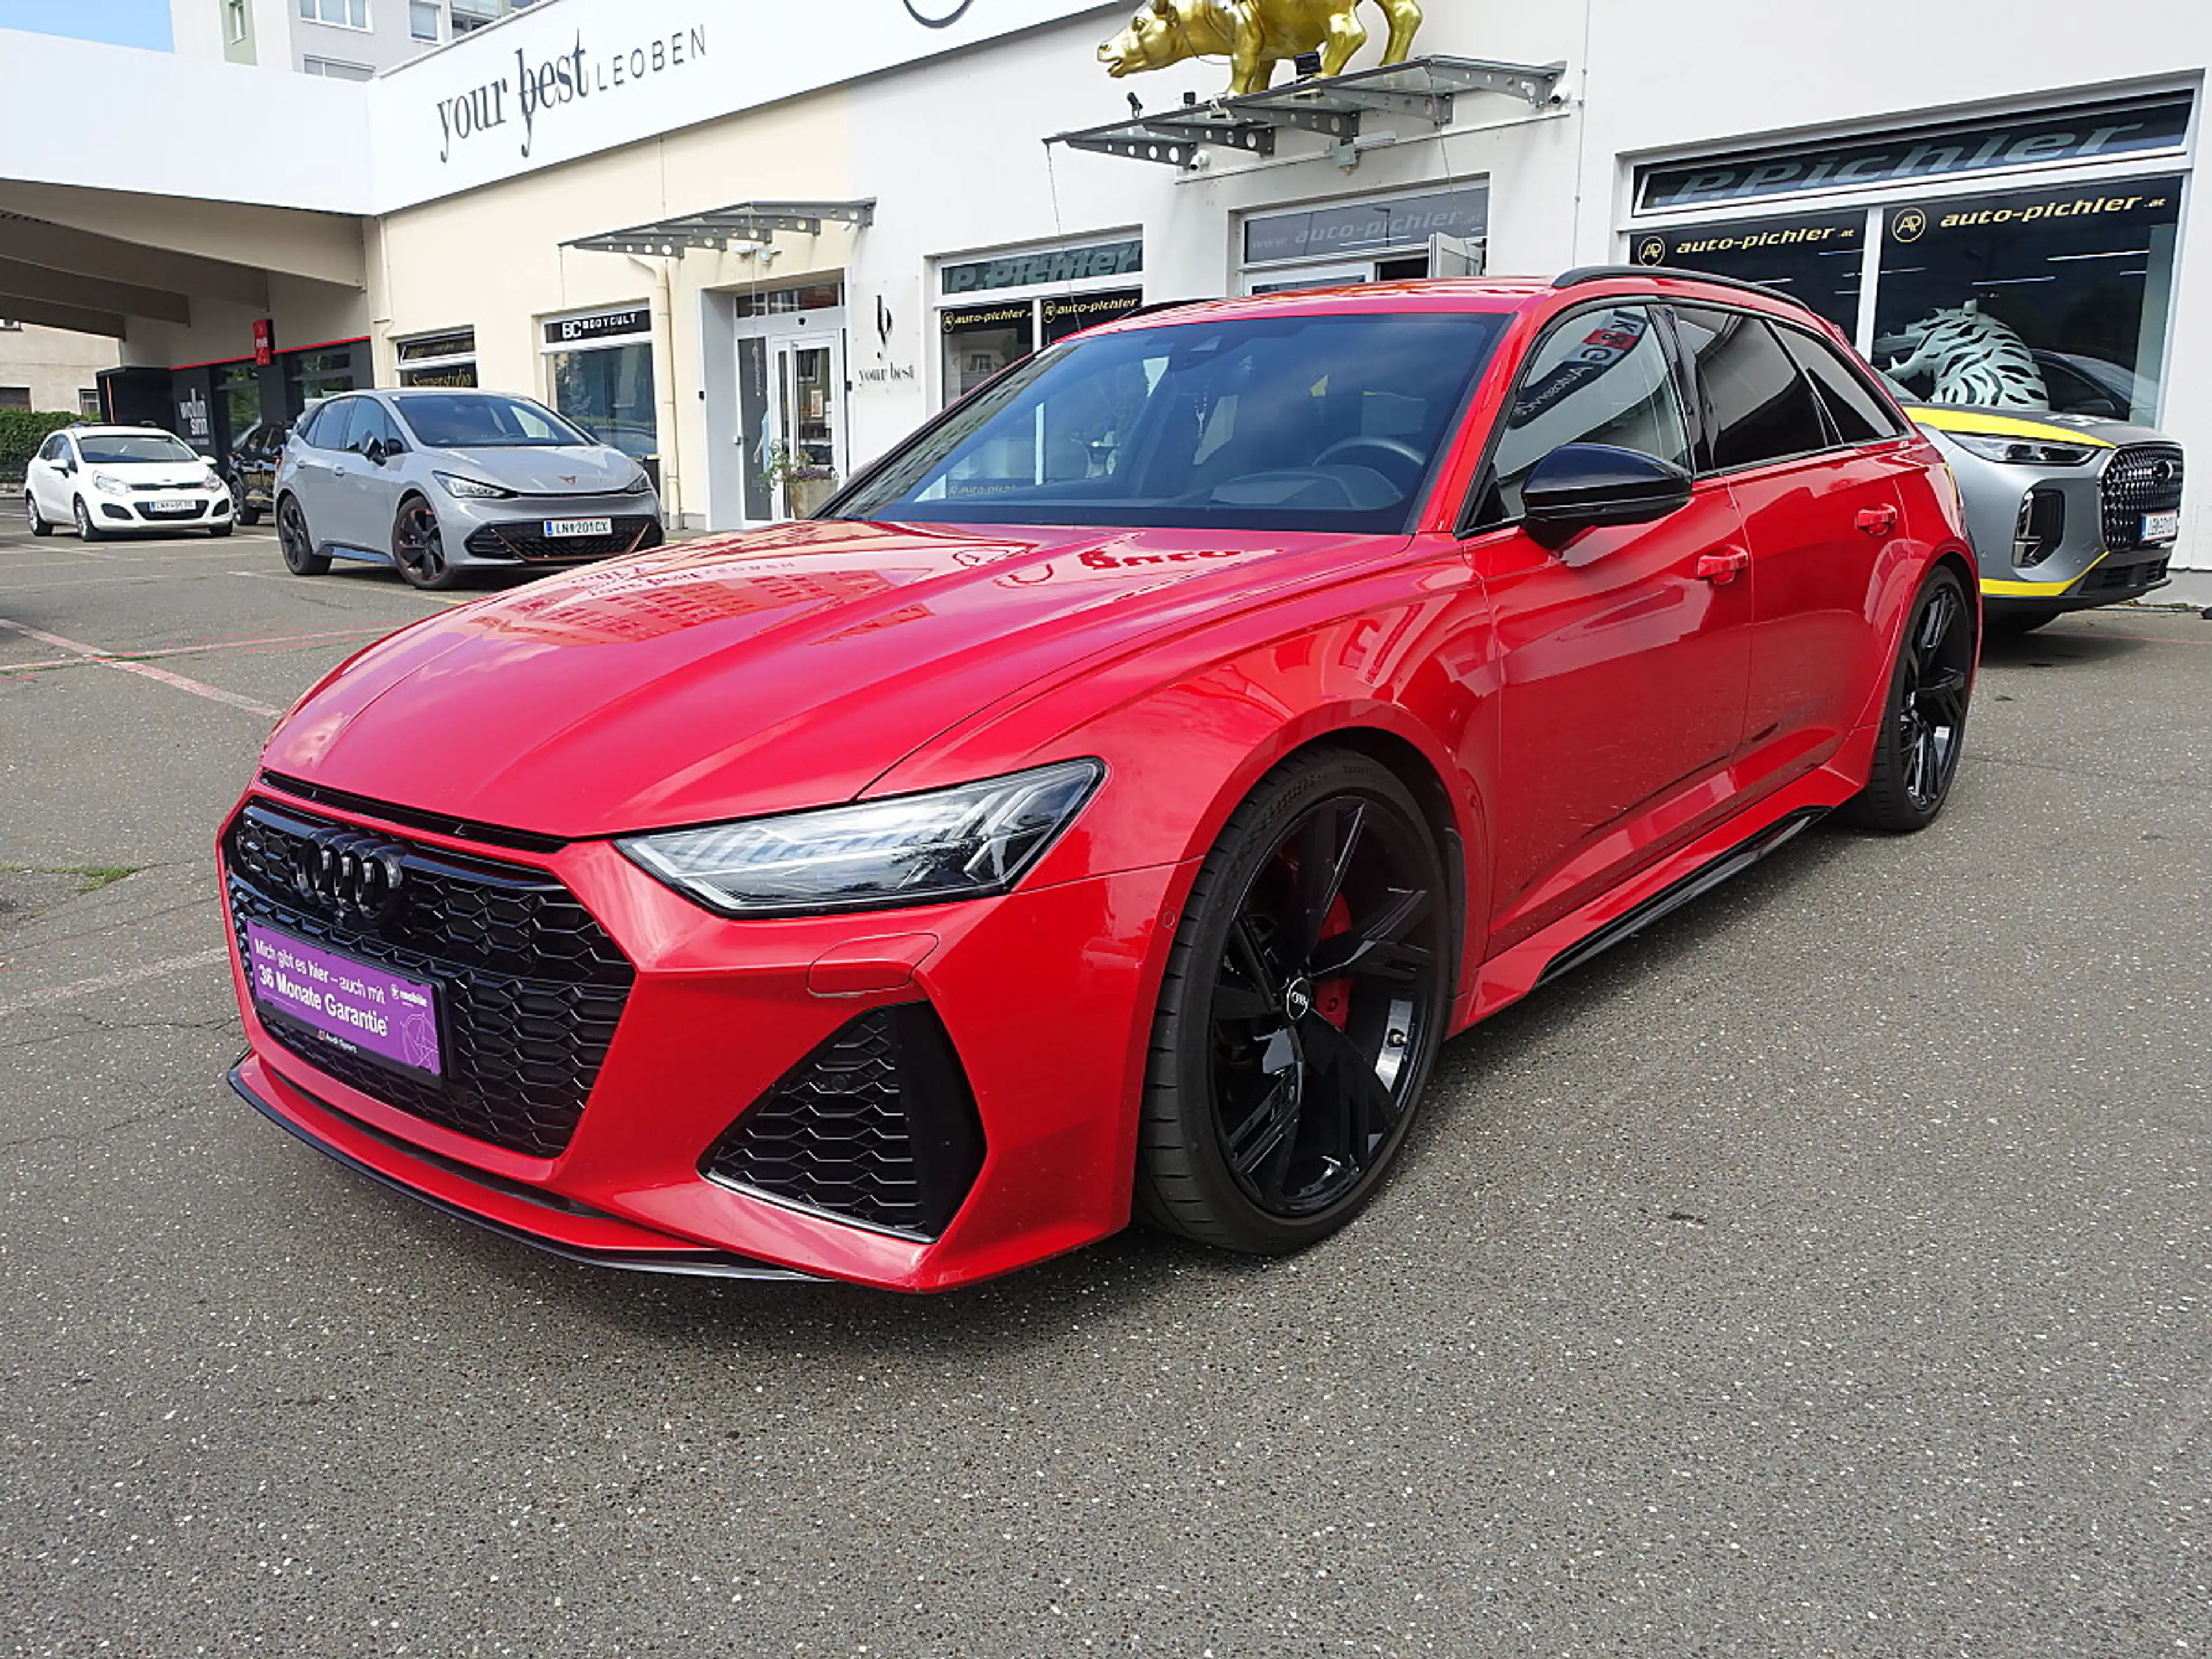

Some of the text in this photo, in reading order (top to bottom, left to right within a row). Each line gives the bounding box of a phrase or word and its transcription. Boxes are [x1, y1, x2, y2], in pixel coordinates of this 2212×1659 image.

[437, 24, 707, 163] your best LEOBEN
[1941, 196, 2143, 228] auto-pichler
[1676, 228, 1836, 254] auto-pichler
[955, 309, 1025, 324] auto-pichler
[1056, 298, 1138, 315] auto-pichler
[254, 938, 277, 961] Mich
[277, 949, 294, 969] gibt
[294, 958, 307, 975] es
[308, 960, 329, 983] hier
[339, 976, 366, 999] auch
[366, 985, 387, 1006] mit
[258, 963, 274, 989] 36
[276, 971, 322, 1011] Monate
